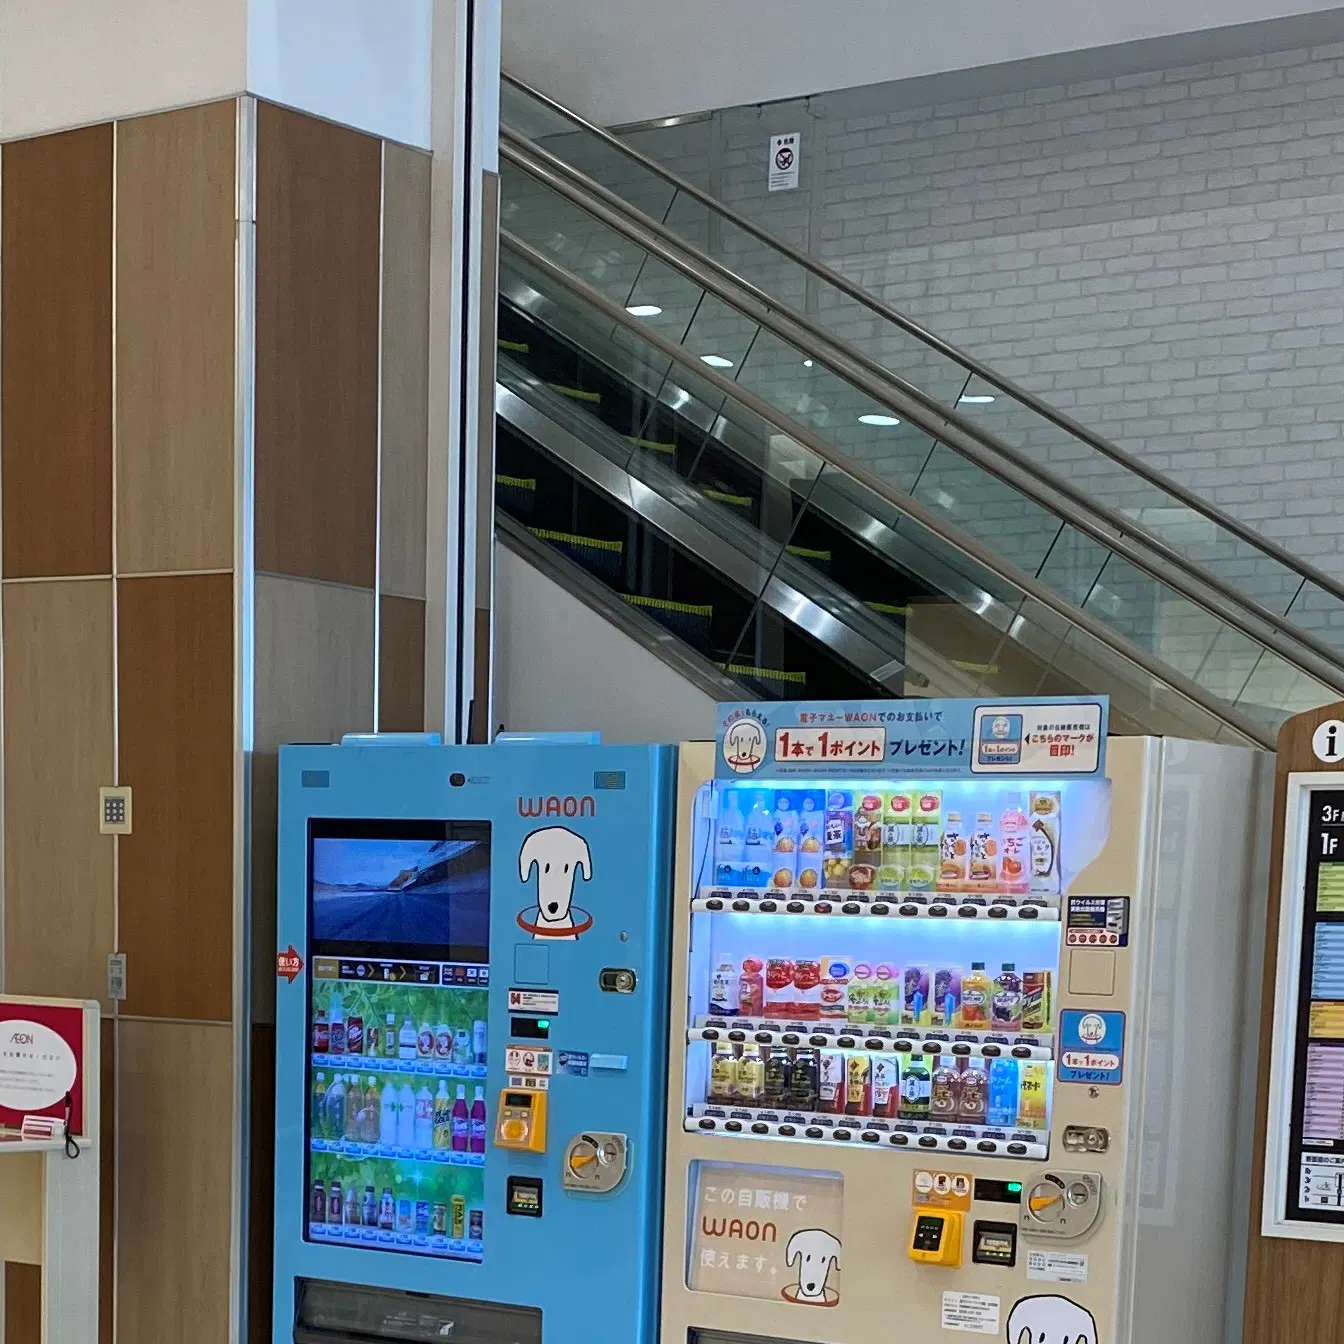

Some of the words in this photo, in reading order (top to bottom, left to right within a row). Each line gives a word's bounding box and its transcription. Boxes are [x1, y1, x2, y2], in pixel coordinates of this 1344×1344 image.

[517, 795, 597, 819] WAON
[1320, 833, 1338, 855] 1F
[704, 1186, 807, 1212] この自販機で
[702, 1215, 777, 1243] WAON
[700, 1248, 778, 1276] 使えます。
